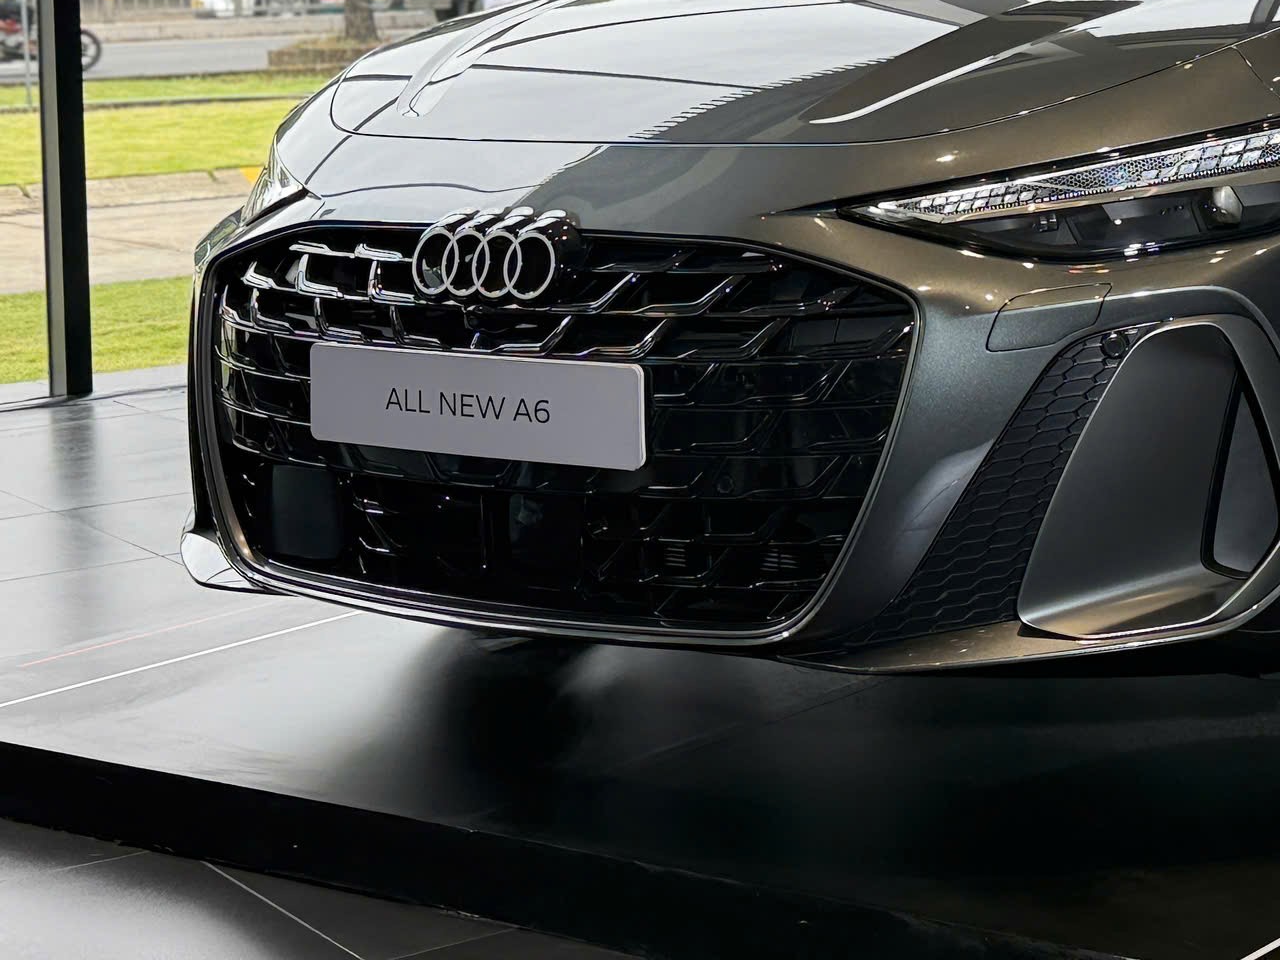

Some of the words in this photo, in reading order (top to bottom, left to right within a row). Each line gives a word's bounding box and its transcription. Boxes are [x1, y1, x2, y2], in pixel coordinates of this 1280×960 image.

[385, 387, 431, 414] ALL
[439, 391, 506, 421] NEW
[512, 397, 551, 424] A6
